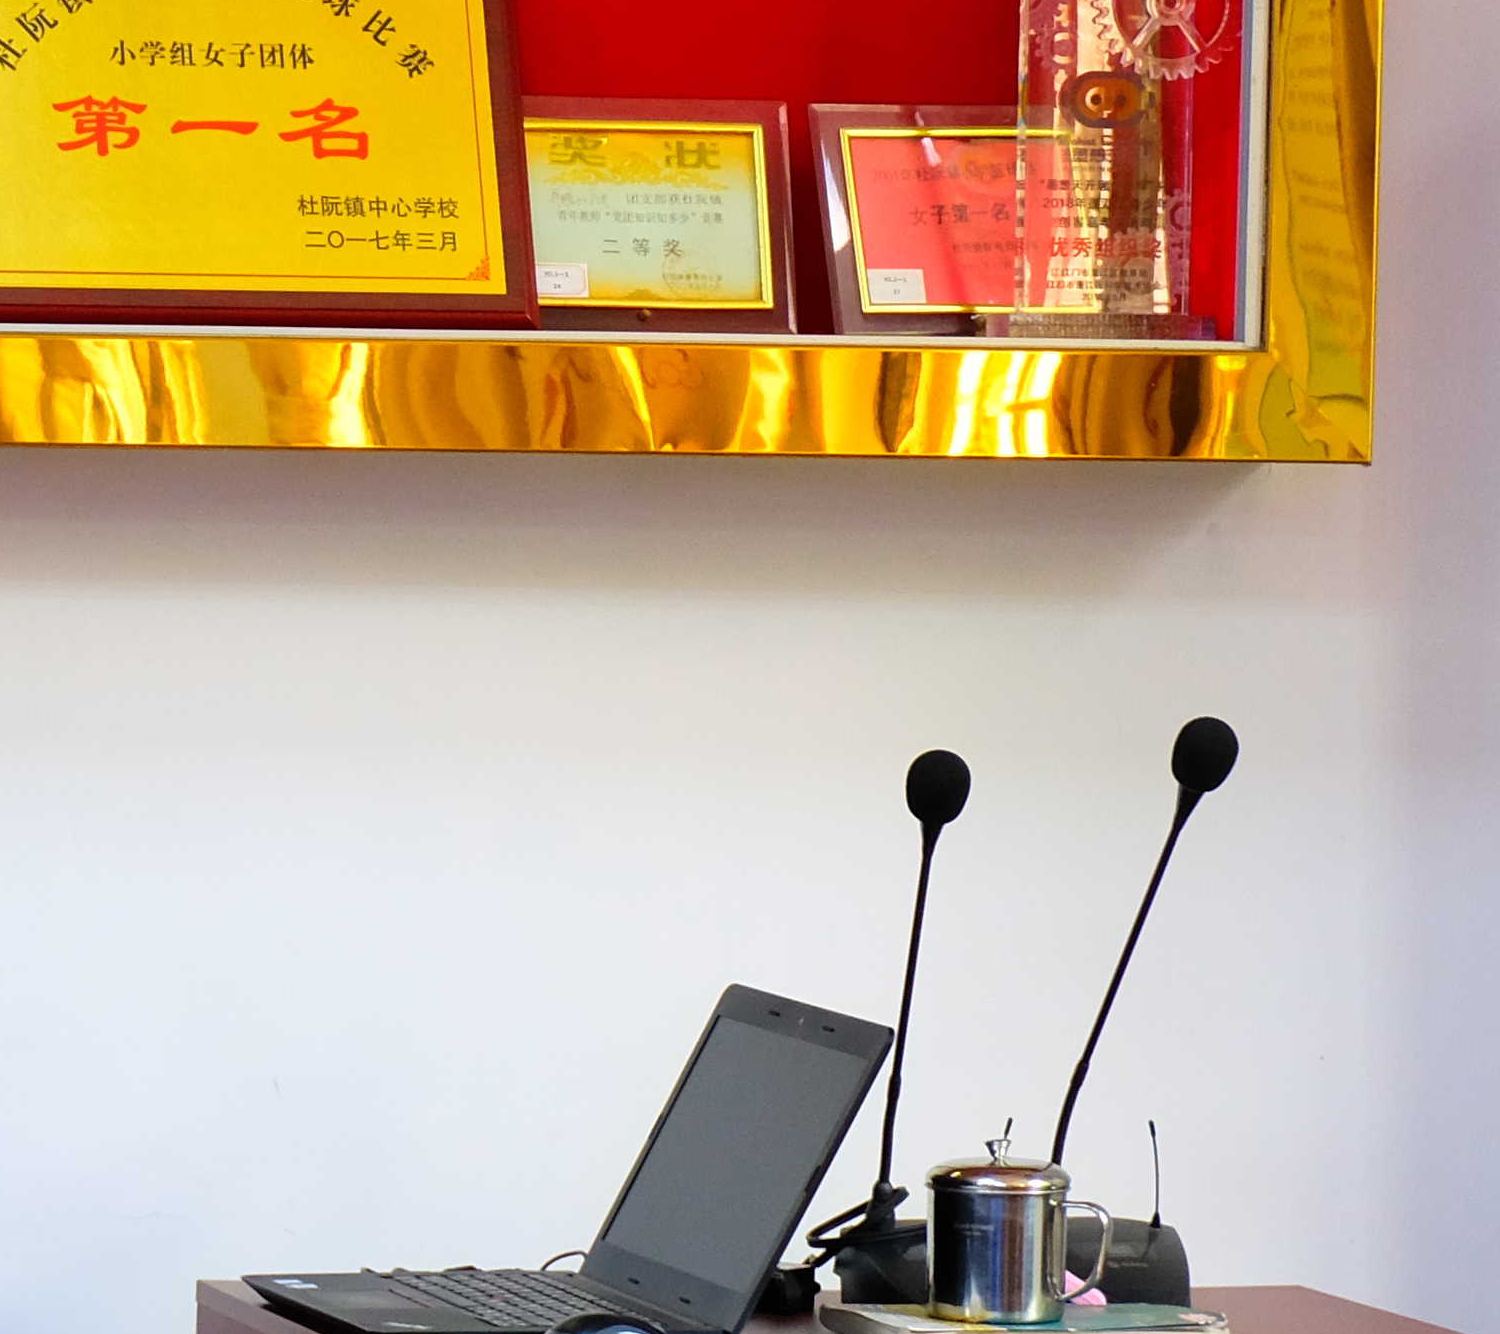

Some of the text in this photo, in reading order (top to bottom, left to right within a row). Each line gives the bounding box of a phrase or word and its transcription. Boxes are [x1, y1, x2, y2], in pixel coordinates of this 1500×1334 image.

[109, 40, 315, 69] 小学组女子团体
[51, 94, 368, 161] 第一名
[549, 135, 721, 170] 奖状
[297, 196, 459, 219] 杜阮镇中心学校
[908, 204, 1011, 226] 女子第一名
[602, 237, 683, 258] 二等奖
